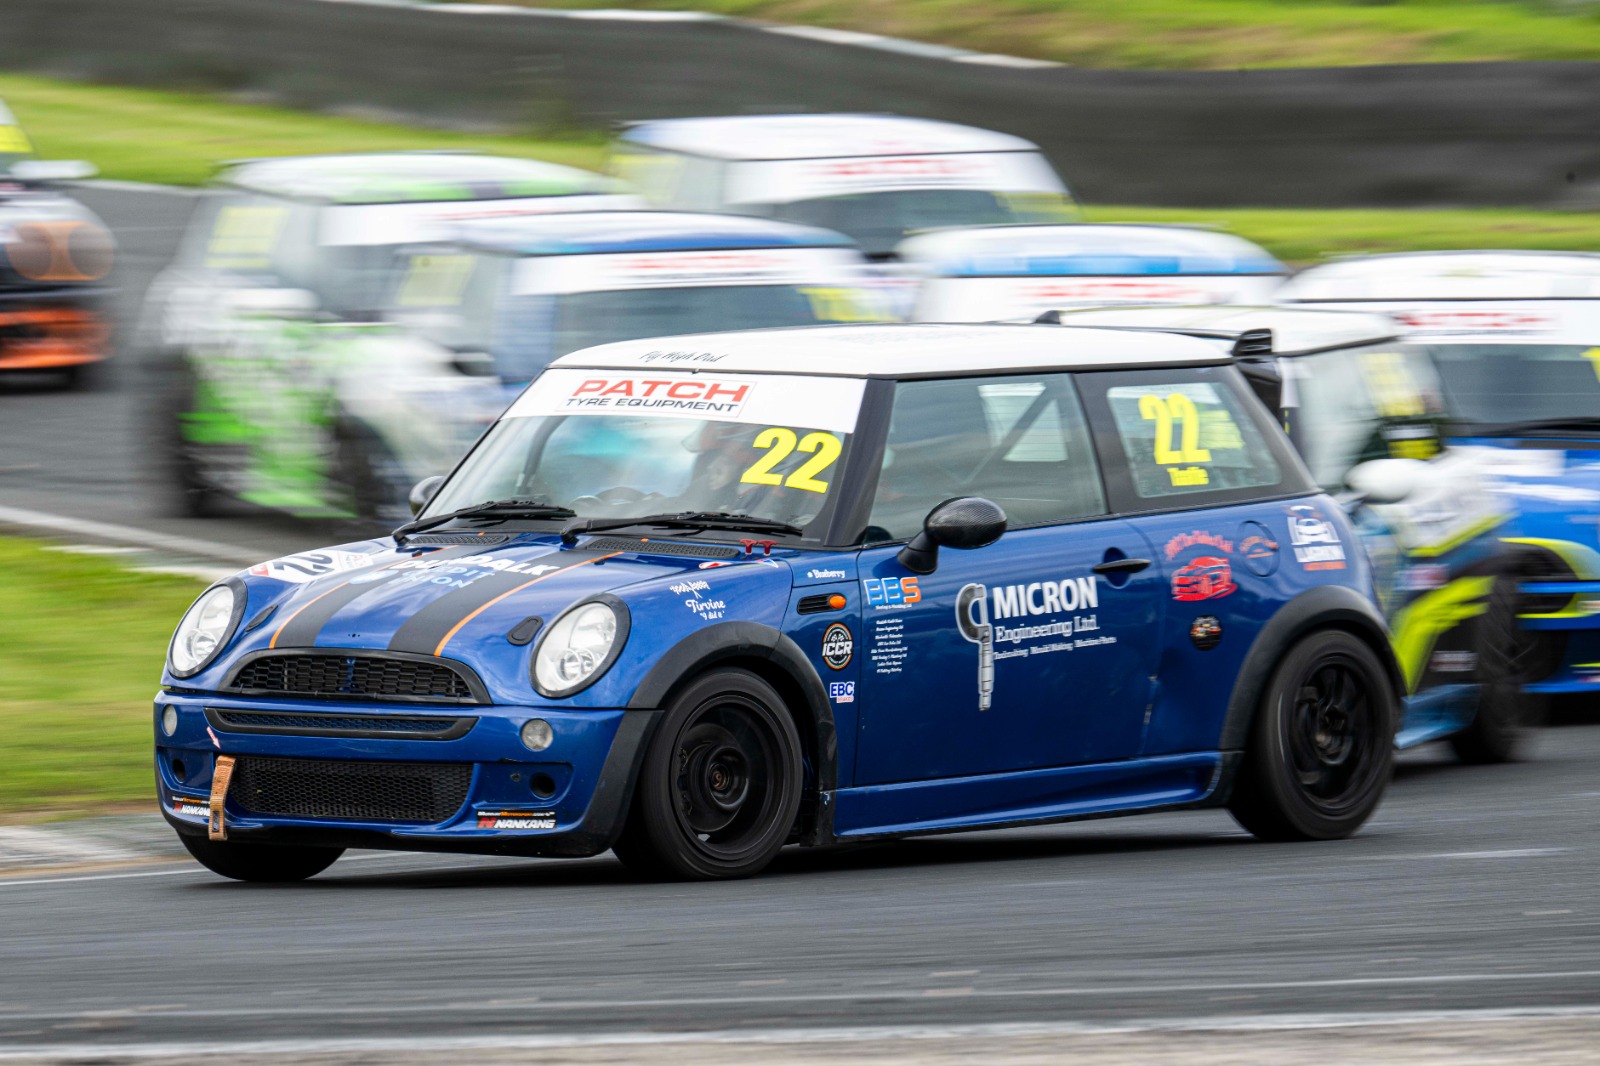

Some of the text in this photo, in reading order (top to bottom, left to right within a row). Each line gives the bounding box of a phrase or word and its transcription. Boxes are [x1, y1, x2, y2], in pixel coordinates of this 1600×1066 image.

[572, 379, 749, 402] PATCH
[566, 398, 739, 413] TYRE EQUIPMENT
[1138, 393, 1212, 465] 22
[740, 427, 842, 494] 22
[992, 576, 1099, 620] MICRON
[994, 619, 1073, 644] Engineering
[822, 641, 853, 657] ICCR
[830, 682, 855, 697] EBC
[494, 819, 557, 829] NANKANG
